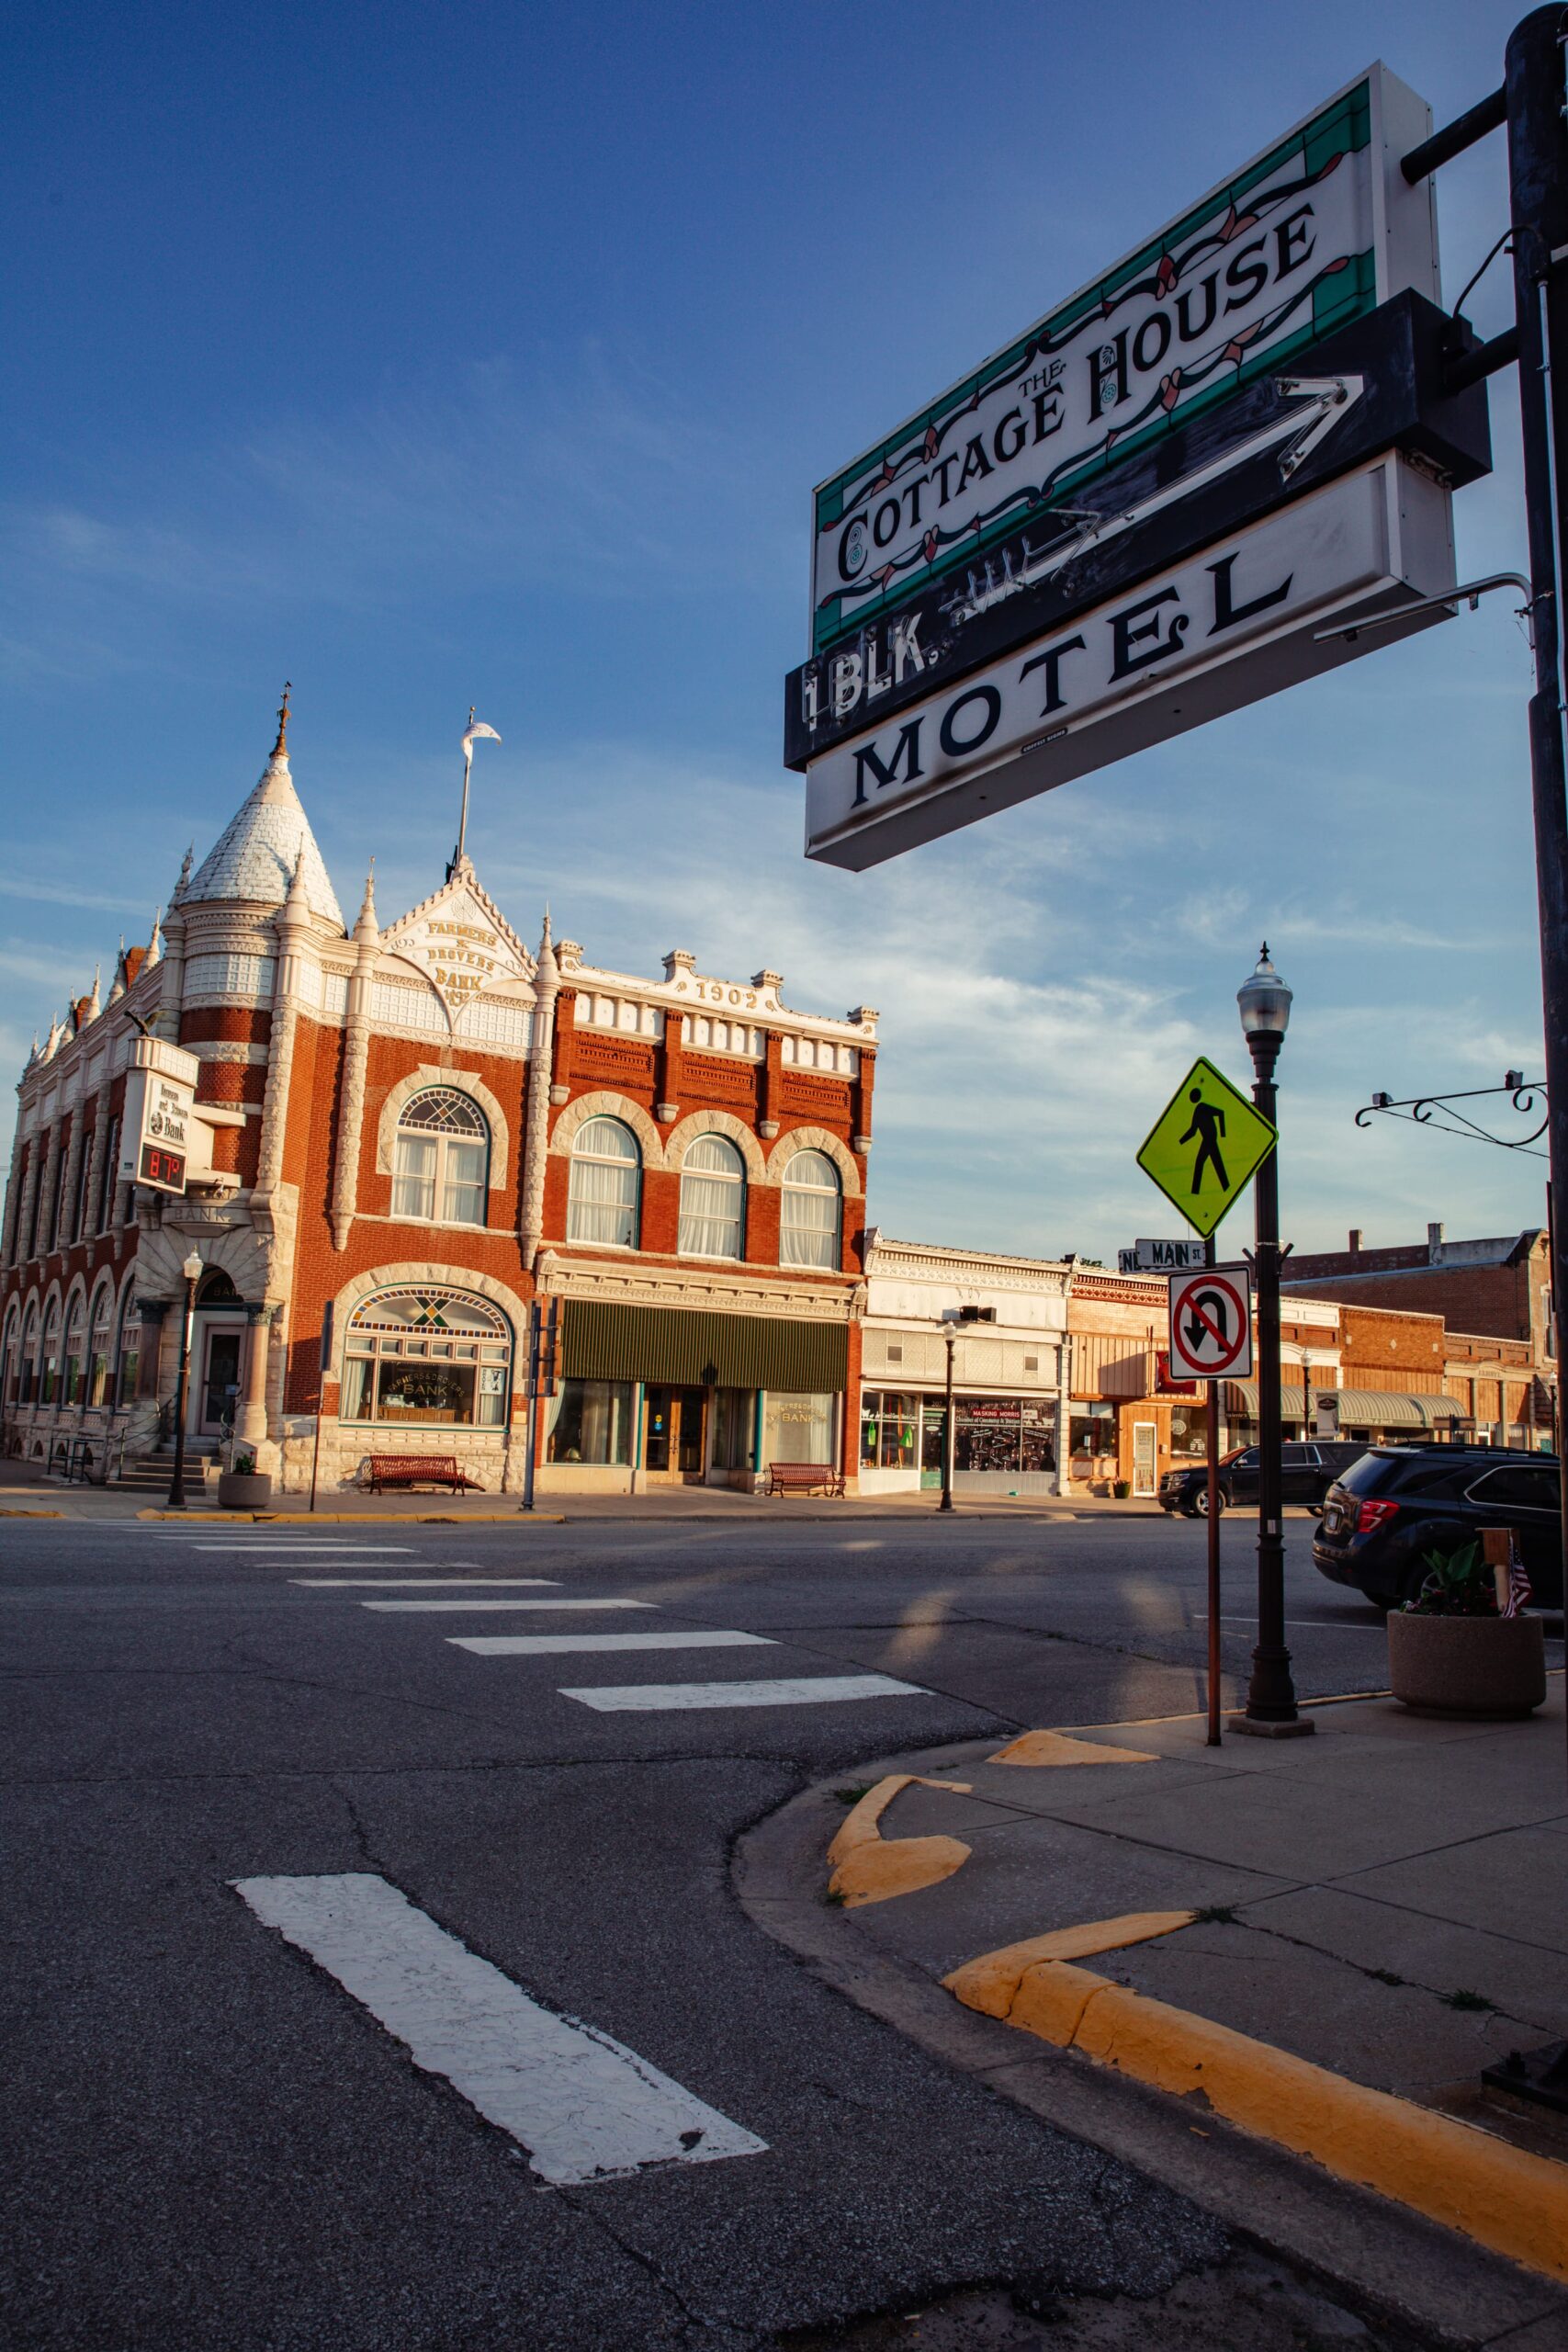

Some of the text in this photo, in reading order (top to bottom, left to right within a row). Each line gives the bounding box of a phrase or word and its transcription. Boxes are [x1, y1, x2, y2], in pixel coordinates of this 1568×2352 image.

[1017, 358, 1066, 398] THE
[837, 201, 1317, 582] COTTAGE HOUSE
[850, 550, 1294, 809] MOTEL
[428, 922, 498, 946] FARMERS
[427, 948, 495, 971] DROVERS
[435, 967, 484, 991] BANK
[696, 982, 758, 1009] 1902
[164, 1116, 185, 1141] Bank
[1152, 1243, 1190, 1264] MAIN
[403, 1384, 447, 1396] BANK
[782, 1412, 816, 1423] BANK
